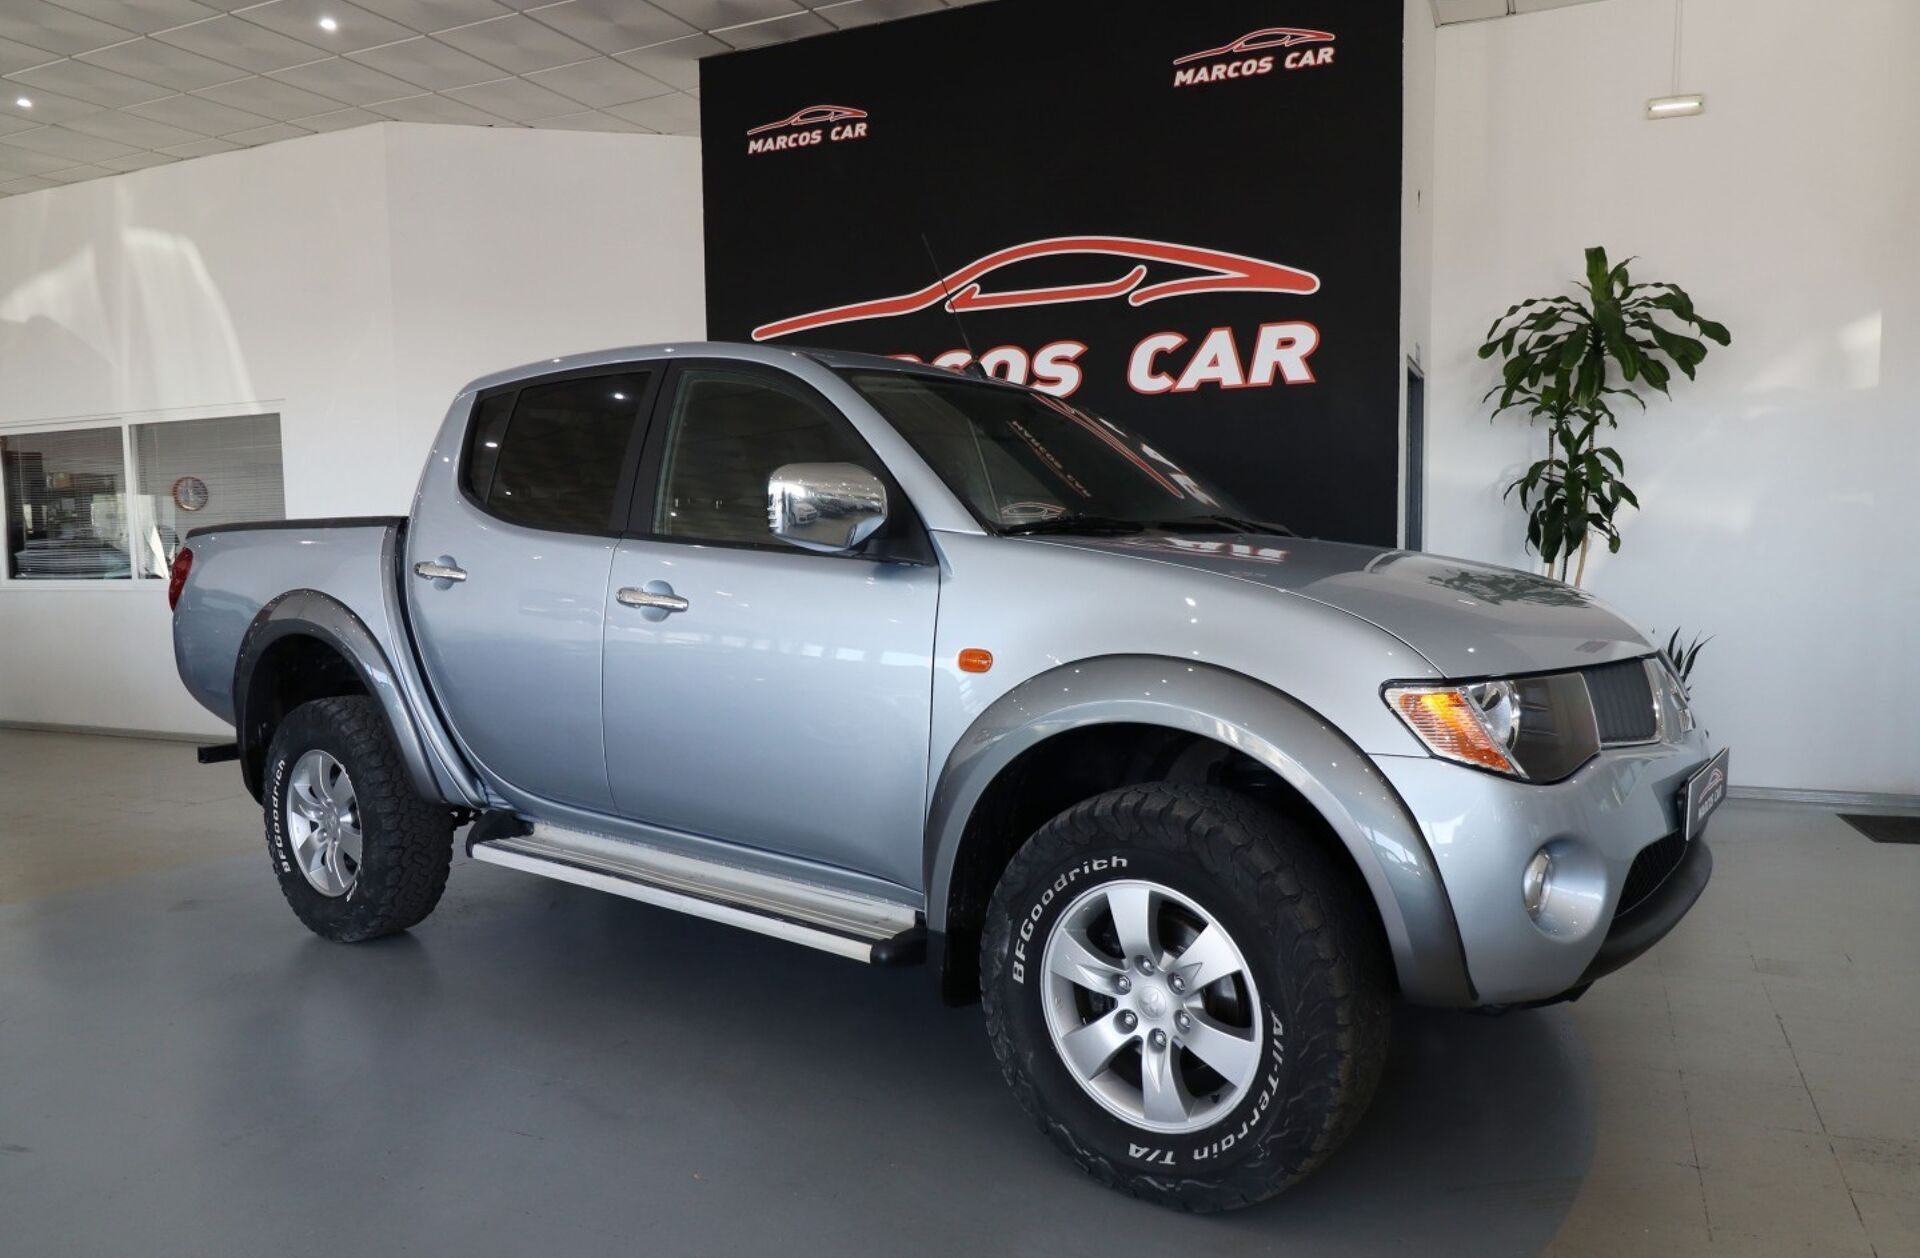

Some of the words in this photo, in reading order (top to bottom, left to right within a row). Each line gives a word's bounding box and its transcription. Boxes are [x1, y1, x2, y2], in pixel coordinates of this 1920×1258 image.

[1173, 56, 1274, 88] MARCOS
[1284, 46, 1335, 70] CAR
[747, 129, 822, 155] MARCOS
[830, 121, 868, 142] CAR
[1127, 320, 1320, 395] CAR
[1012, 855, 1128, 985] BFGoodrich
[1193, 1010, 1284, 1161] All-Terrain
[1128, 1142, 1177, 1165] T/A
